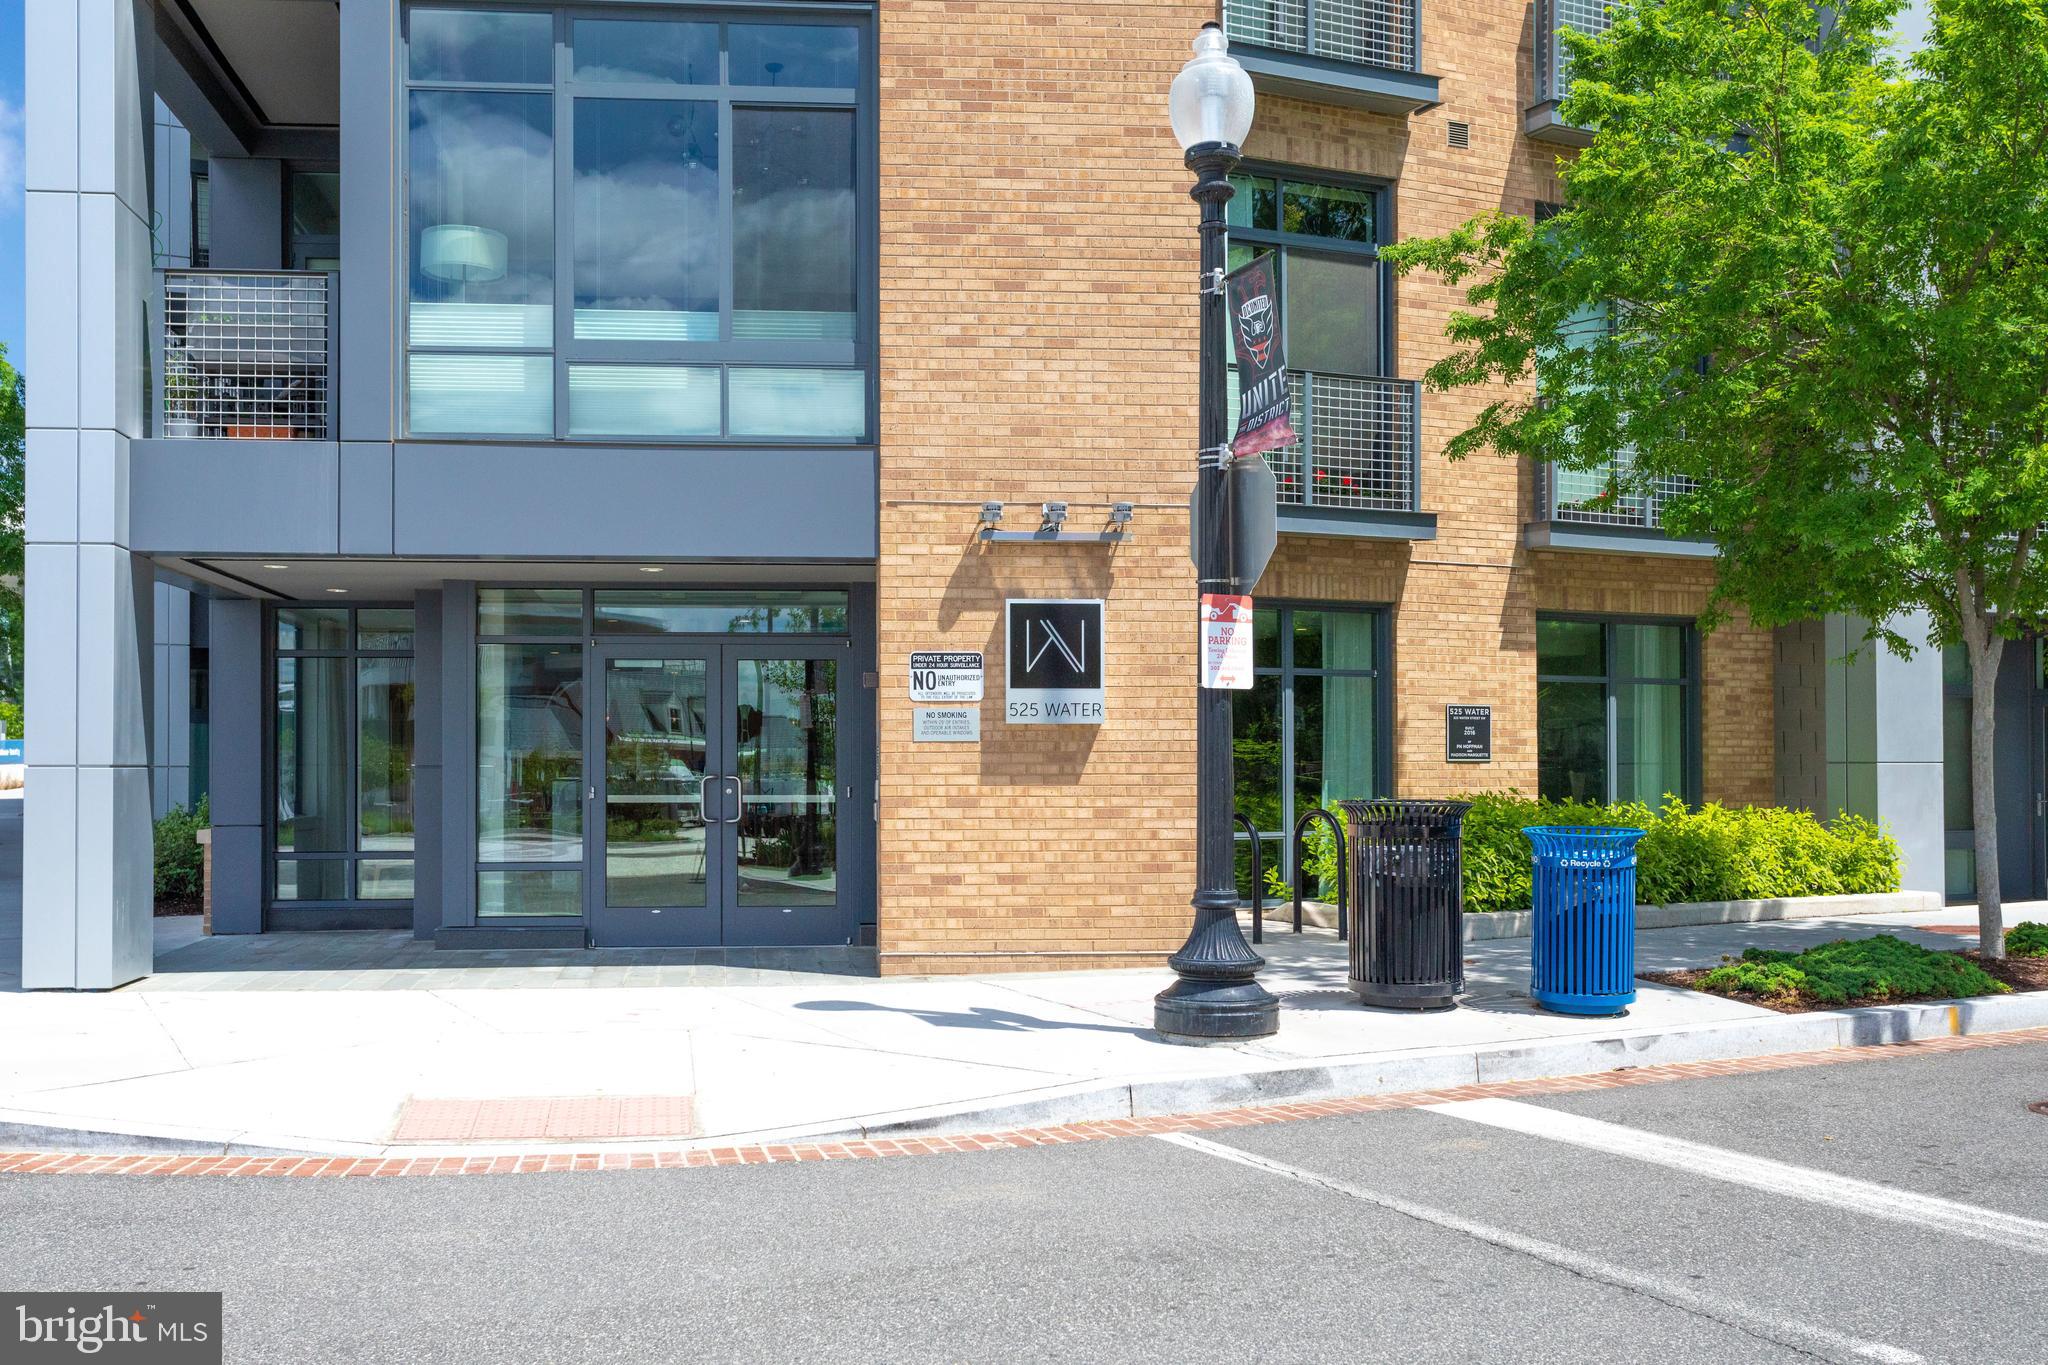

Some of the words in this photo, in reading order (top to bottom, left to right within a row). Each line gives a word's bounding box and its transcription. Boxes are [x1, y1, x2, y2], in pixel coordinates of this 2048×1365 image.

[1247, 397, 1290, 432] DISTRICT
[1208, 636, 1247, 646] PARKING
[913, 671, 936, 690] NO
[1009, 703, 1039, 717] 525
[1045, 703, 1102, 717] WATER
[1465, 708, 1489, 716] WATER
[1570, 860, 1601, 868] Recycle
